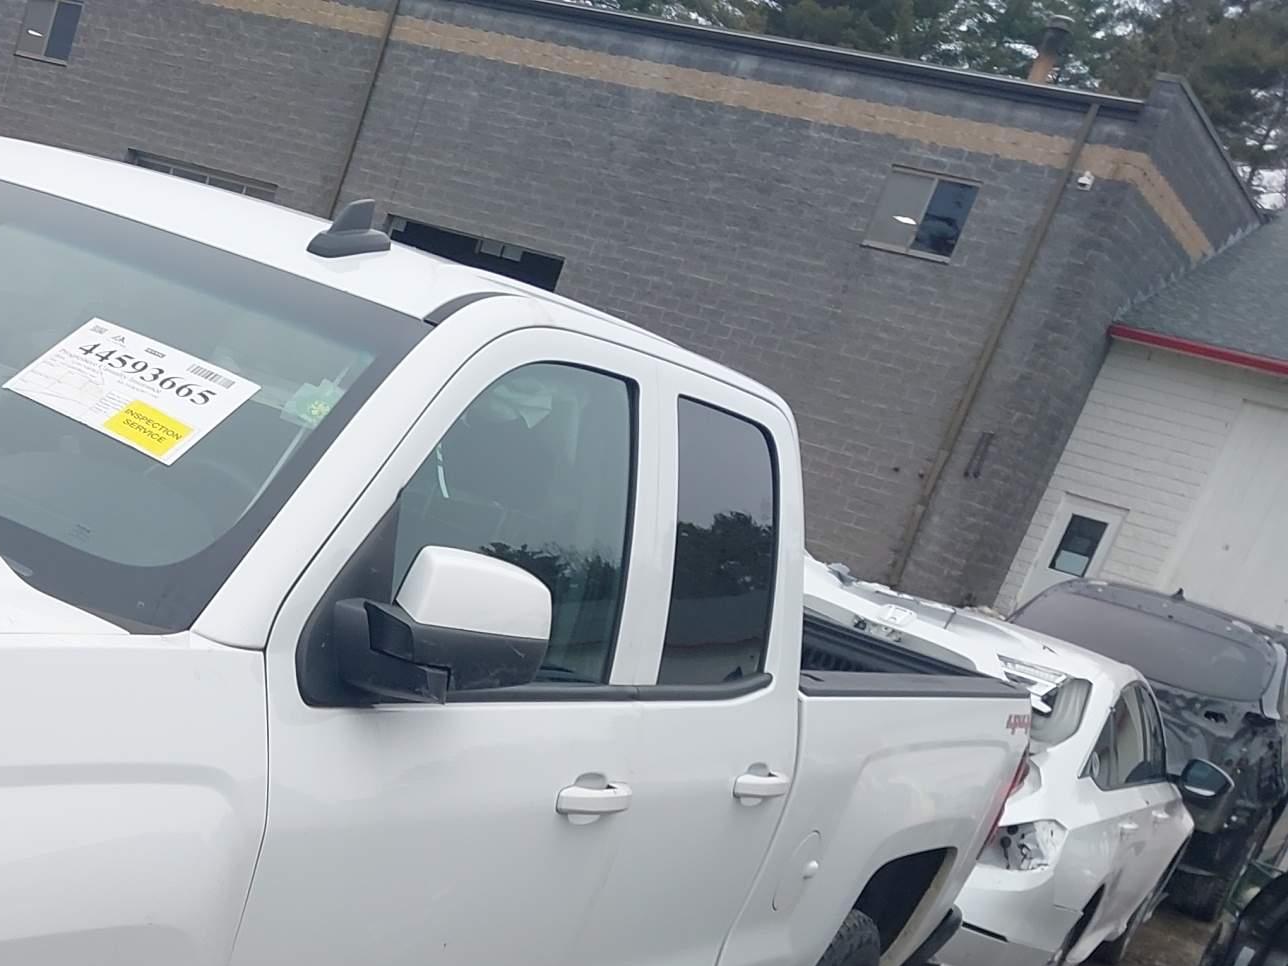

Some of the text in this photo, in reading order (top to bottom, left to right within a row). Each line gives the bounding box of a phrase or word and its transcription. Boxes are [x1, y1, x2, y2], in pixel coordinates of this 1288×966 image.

[79, 343, 216, 405] 44593665
[123, 418, 166, 443] SERVICE
[125, 408, 182, 441] INSPECTION
